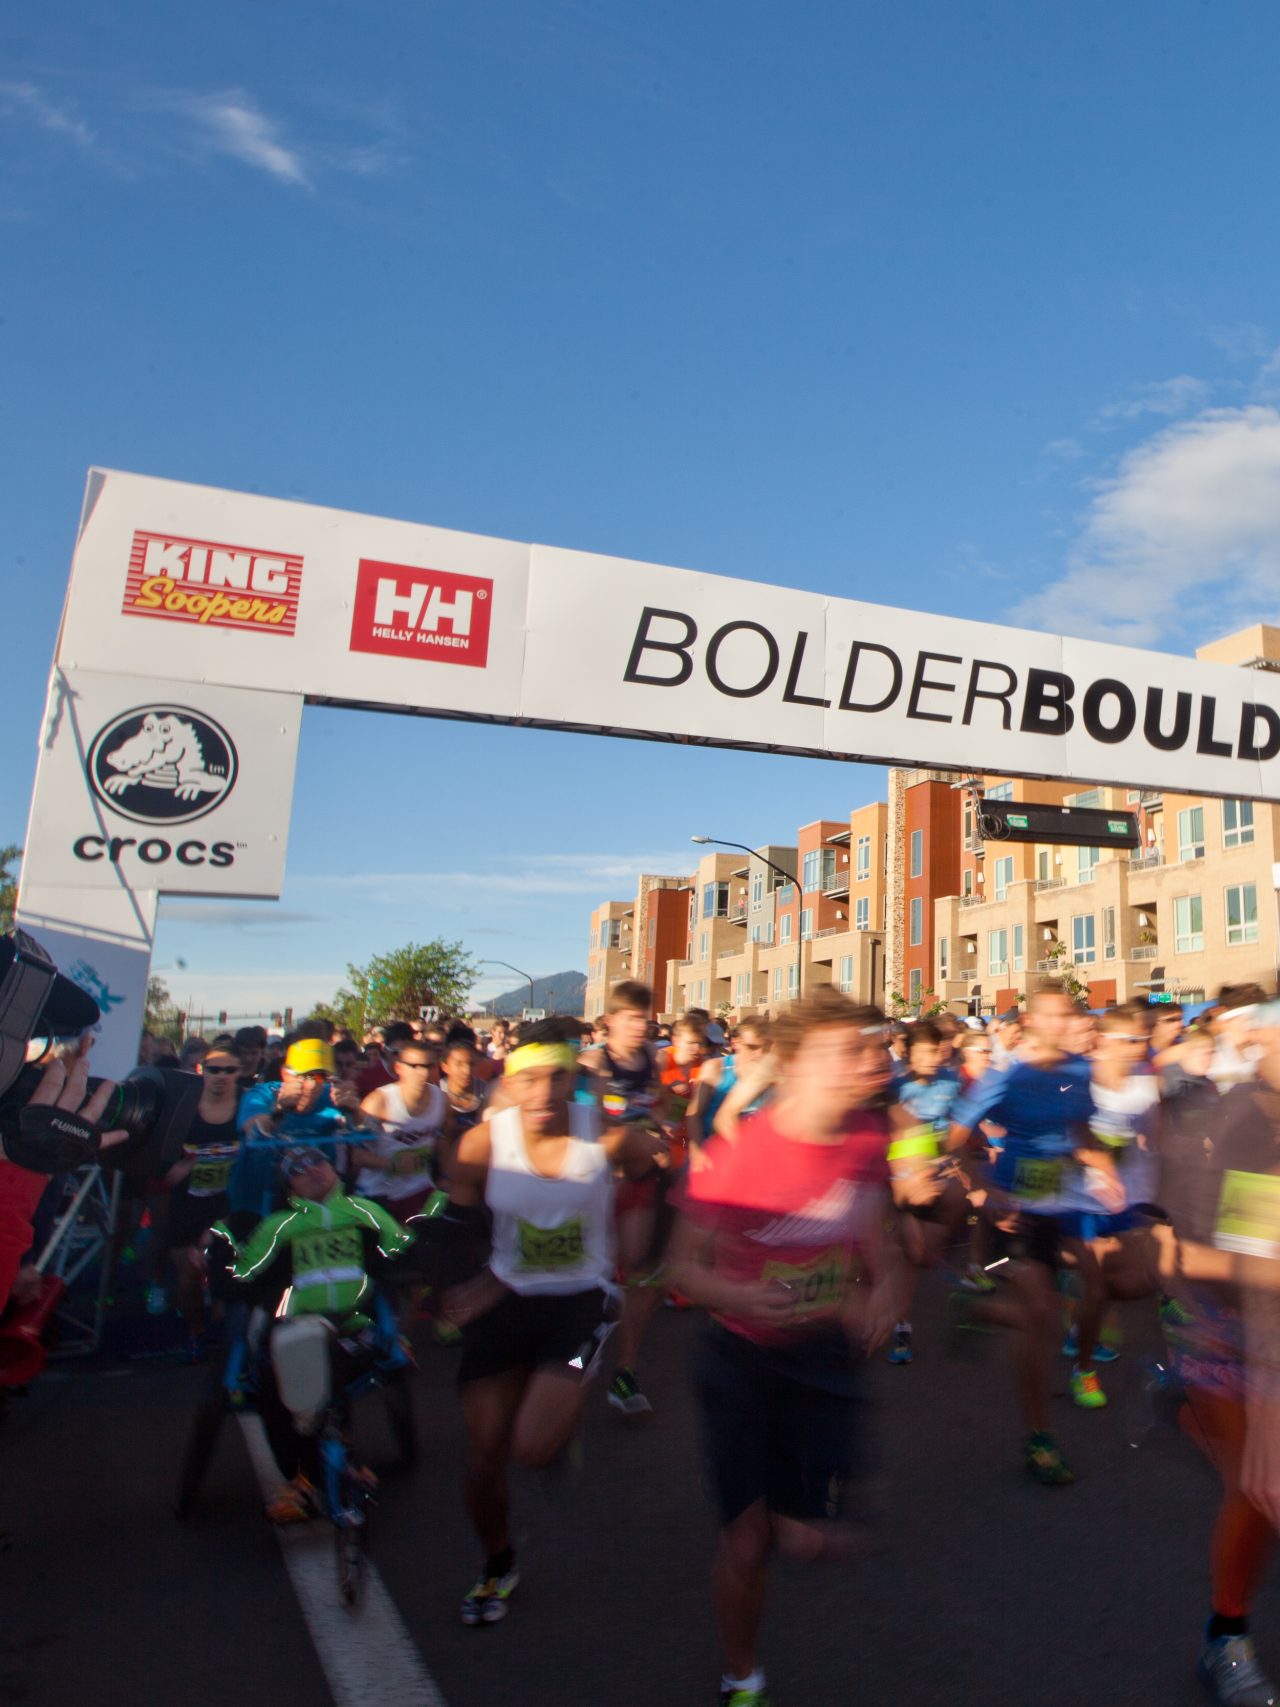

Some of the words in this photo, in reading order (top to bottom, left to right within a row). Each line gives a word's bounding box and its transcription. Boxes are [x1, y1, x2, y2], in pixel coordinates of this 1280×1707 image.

[143, 540, 289, 594] KING
[134, 576, 288, 624] Soopers
[372, 627, 413, 641] HELLY
[416, 632, 469, 649] HANSEN
[73, 835, 235, 868] crocs
